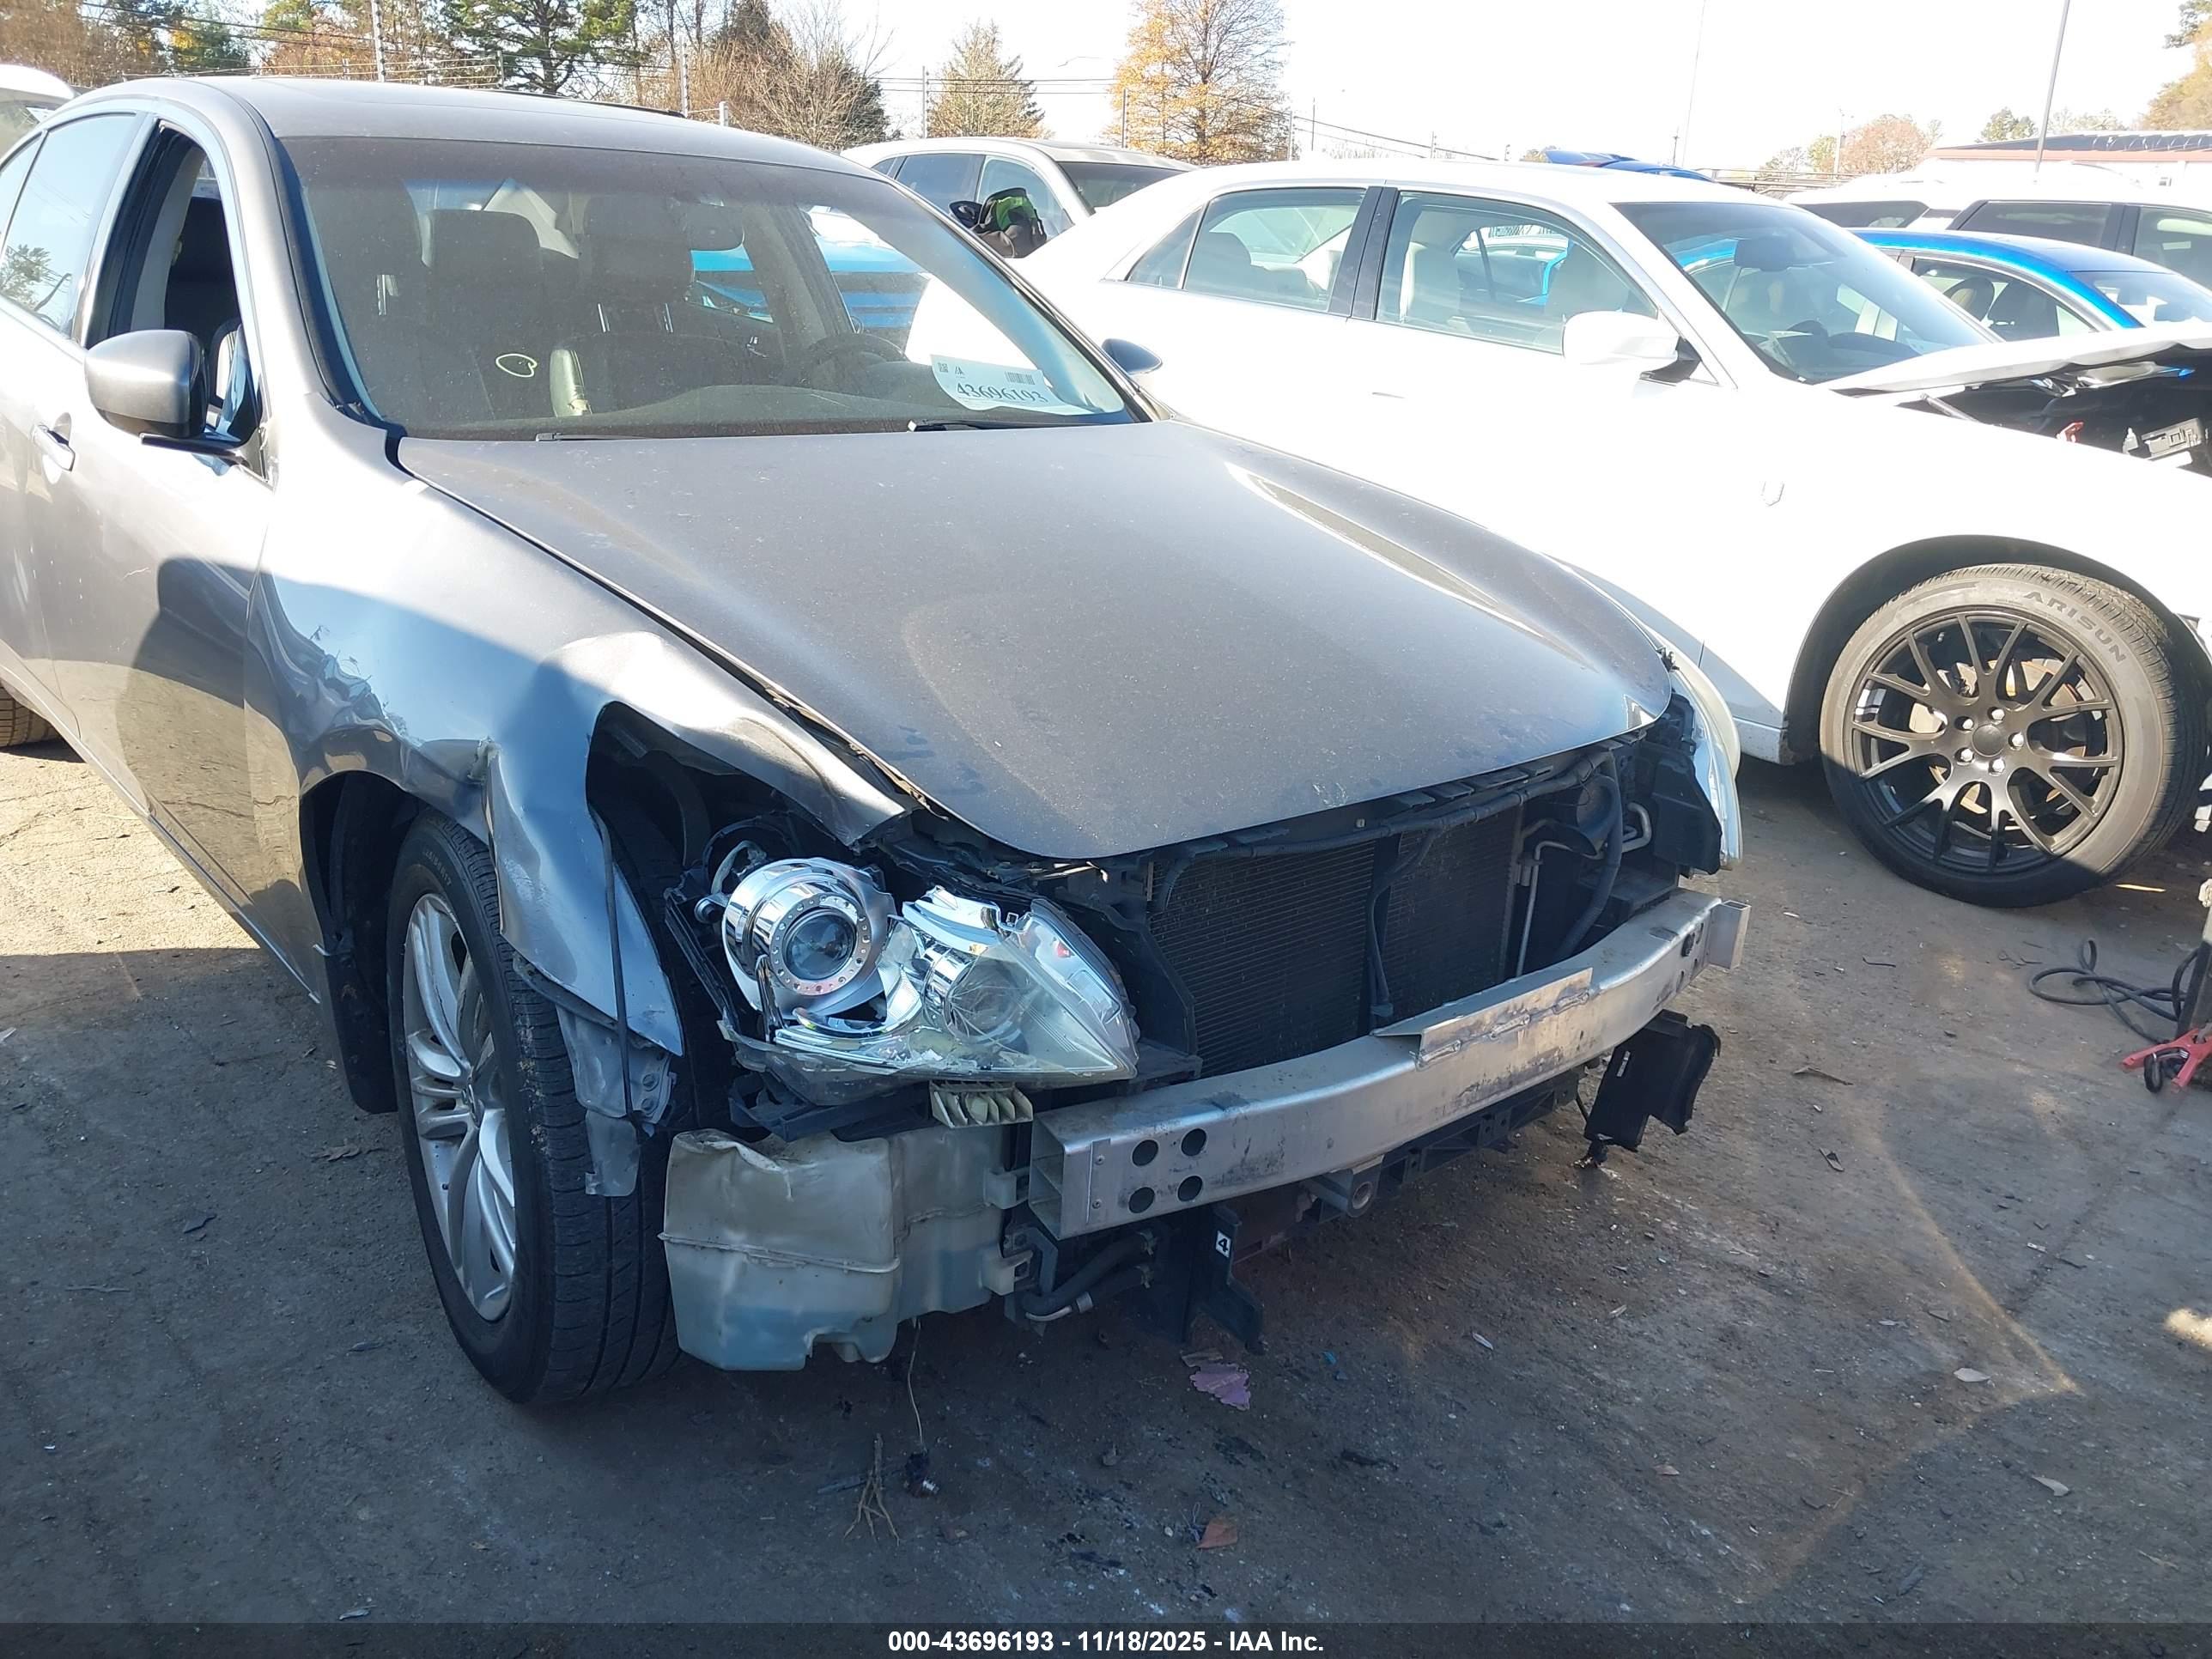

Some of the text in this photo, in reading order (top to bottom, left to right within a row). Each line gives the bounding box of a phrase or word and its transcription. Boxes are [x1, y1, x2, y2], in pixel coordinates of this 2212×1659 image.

[957, 383, 1048, 403] 43696193
[2024, 591, 2126, 663] ARISUN
[1218, 1237, 1229, 1253] 4
